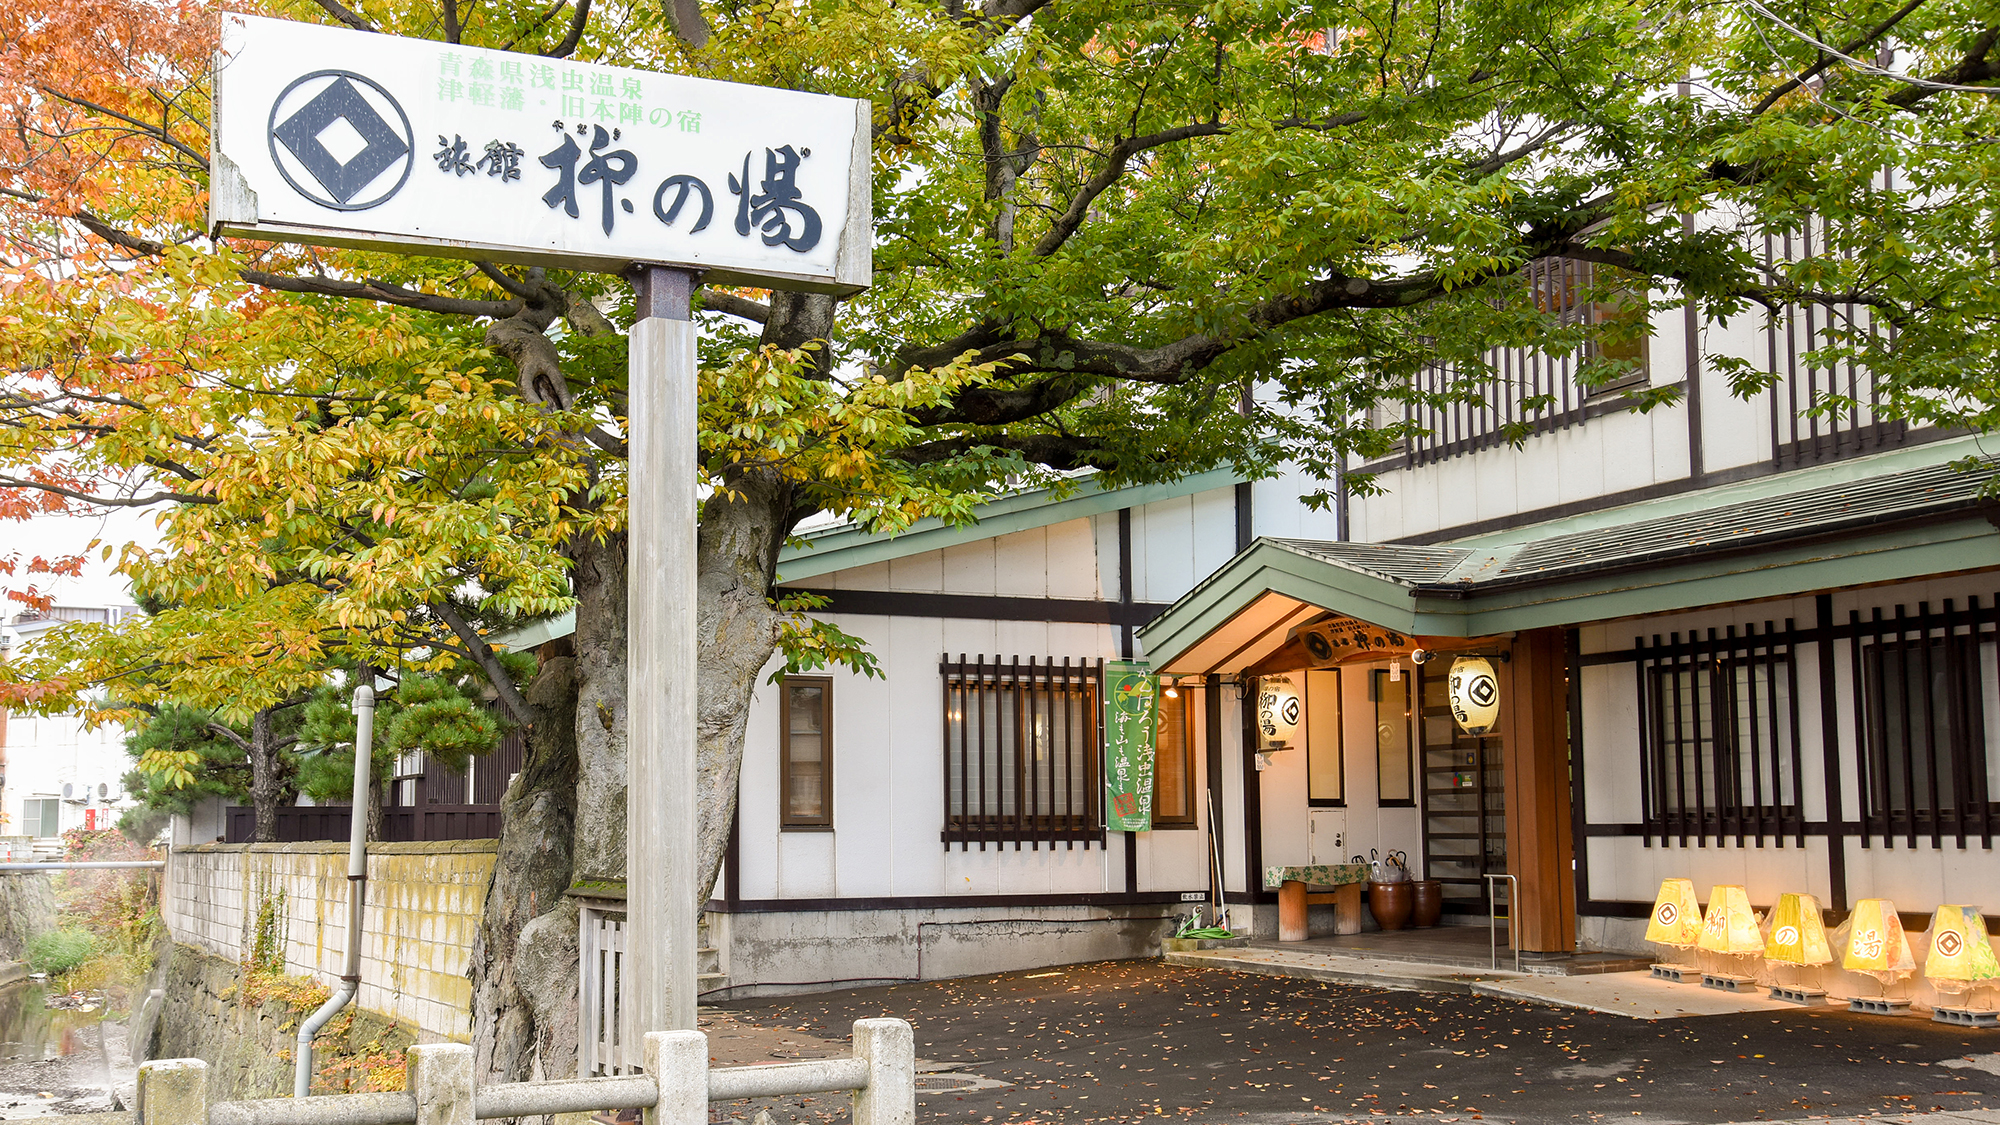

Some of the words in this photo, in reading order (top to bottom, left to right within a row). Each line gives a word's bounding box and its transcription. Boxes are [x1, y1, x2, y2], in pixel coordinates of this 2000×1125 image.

[437, 51, 643, 100] 青森県浅虫温泉
[437, 77, 702, 134] 津軽藩・旧本陣の宿
[552, 119, 621, 141] やなぎ
[433, 134, 525, 183] 旅館
[538, 123, 823, 253] 柳の湯
[1259, 692, 1278, 736] 柳の湯
[1114, 711, 1132, 794] 海も山も温泉も
[1705, 907, 1726, 938] 柳
[1776, 927, 1798, 945] の
[1853, 930, 1882, 958] 湯
